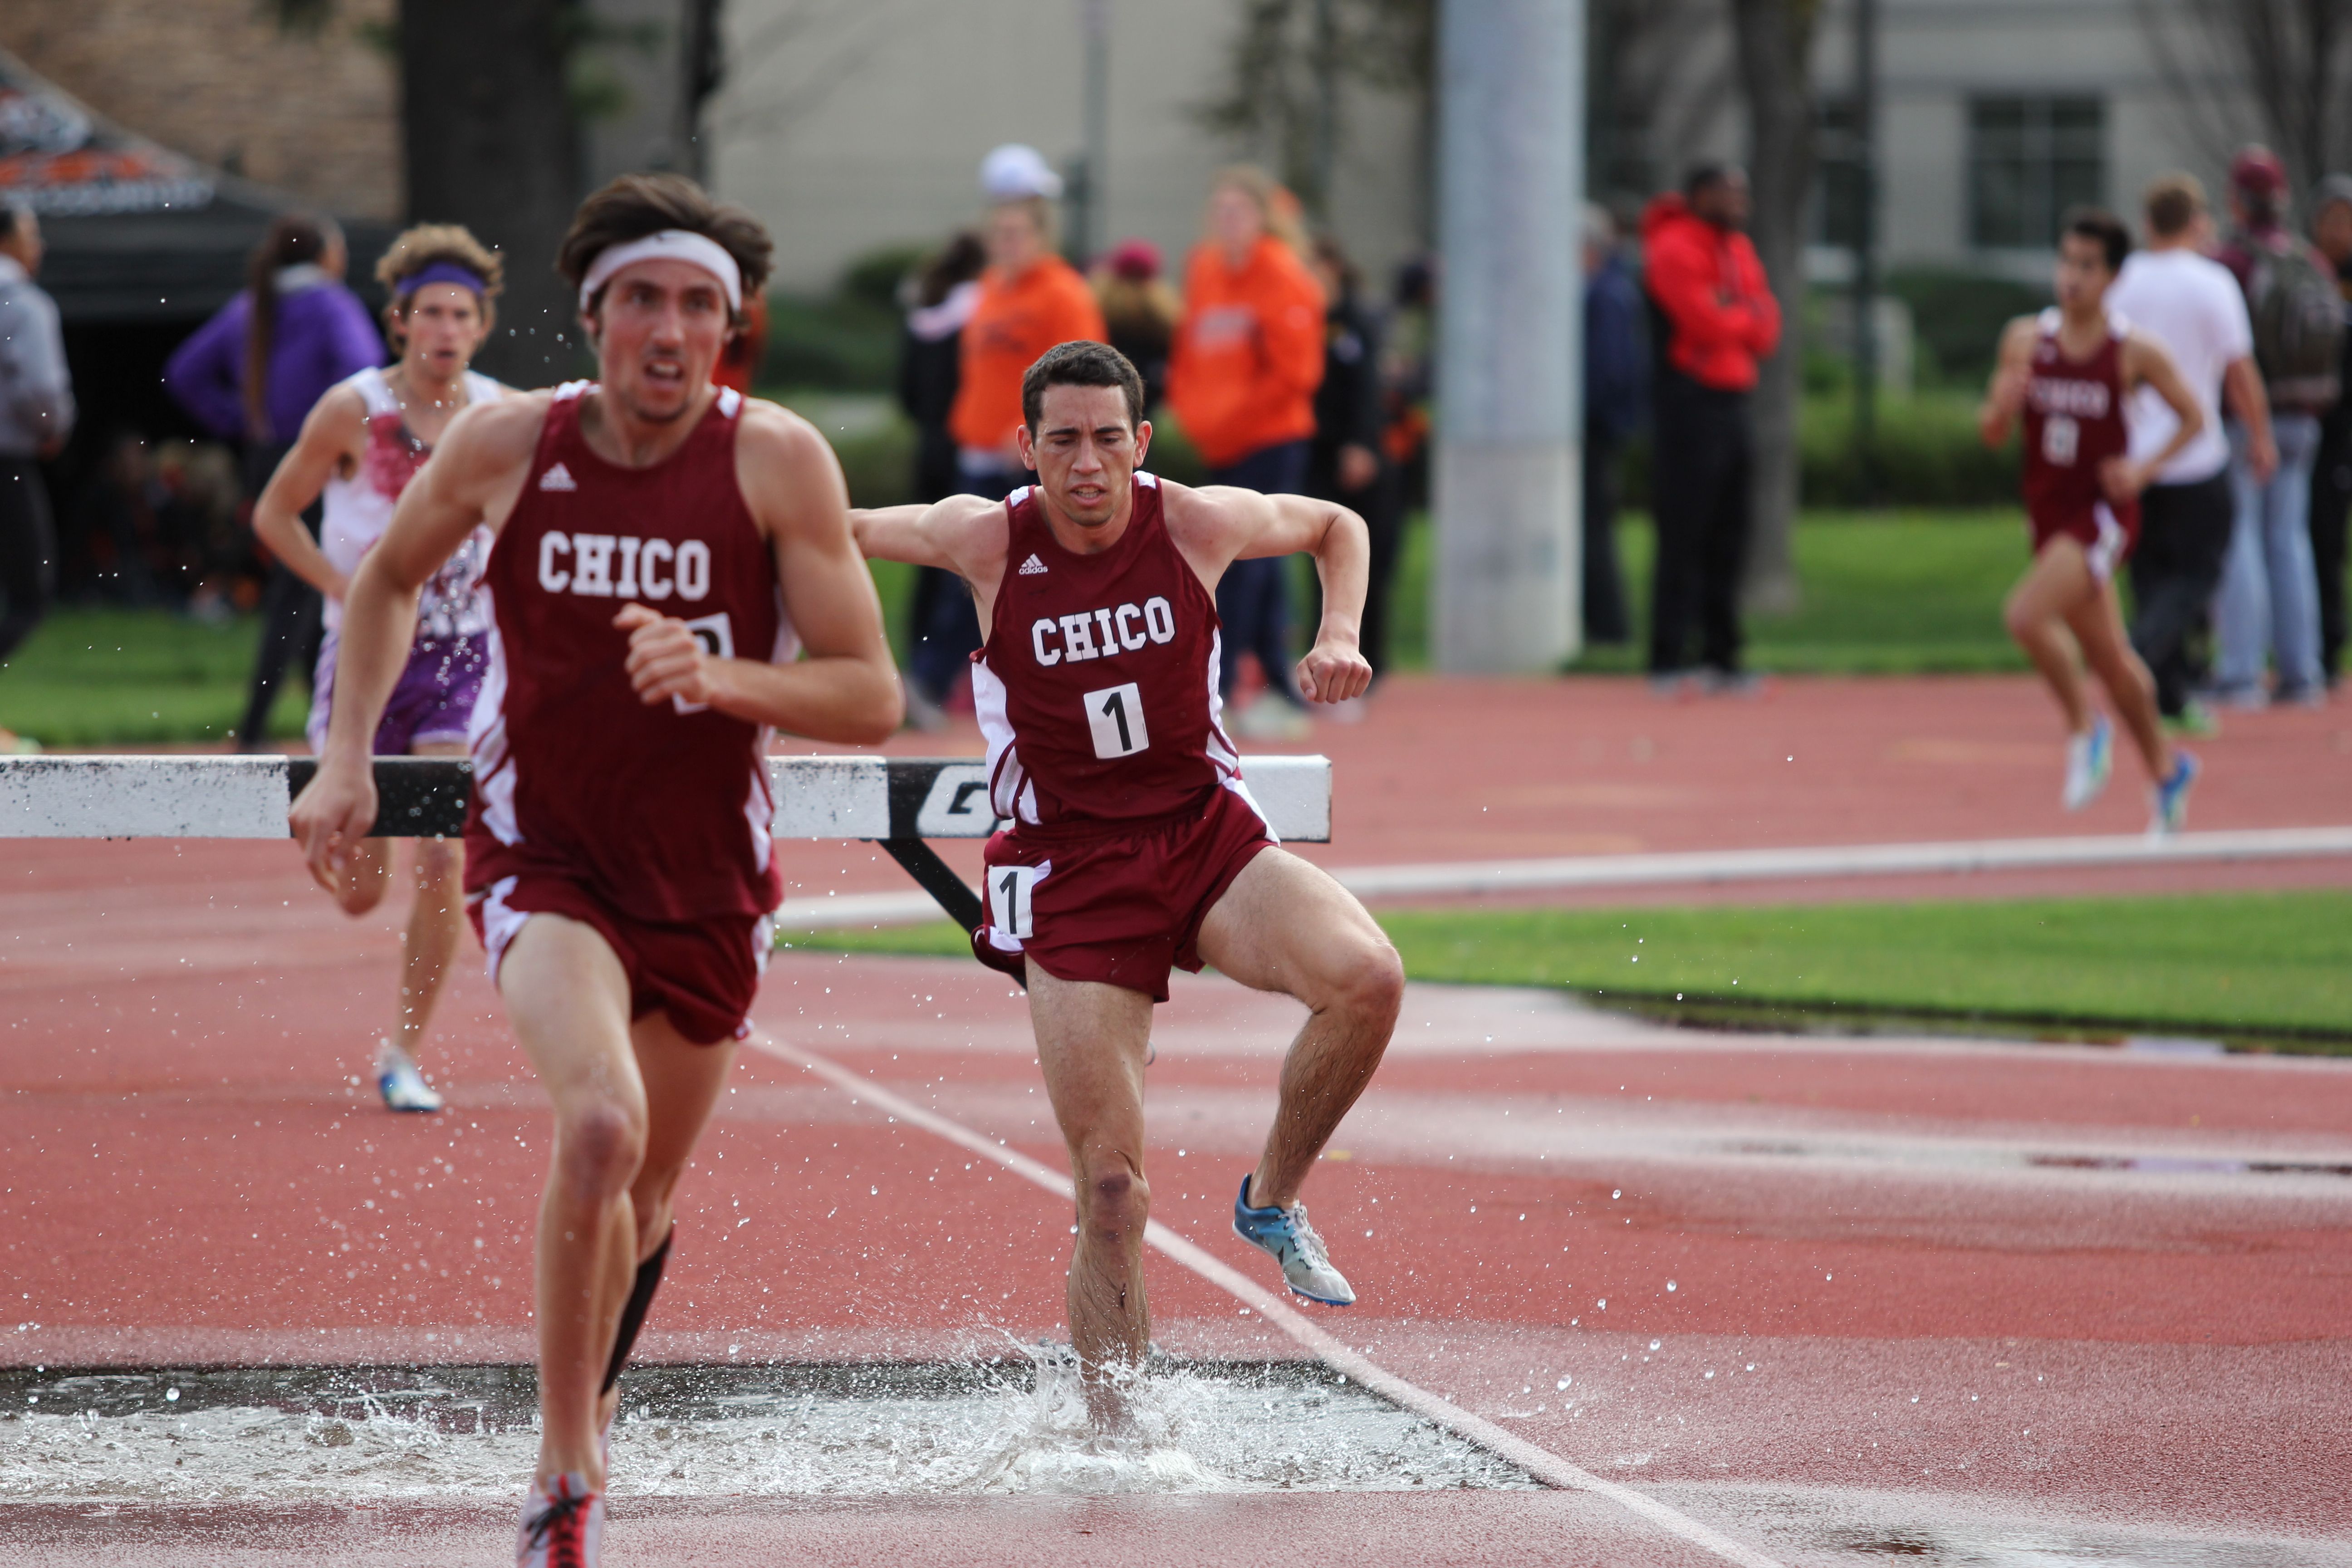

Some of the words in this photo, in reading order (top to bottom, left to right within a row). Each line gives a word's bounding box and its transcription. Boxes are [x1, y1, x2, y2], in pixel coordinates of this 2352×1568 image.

[539, 530, 710, 601] CHICO
[1019, 565, 1048, 575] adidas
[1031, 596, 1176, 666] CHICO
[1102, 691, 1133, 751] 1
[999, 871, 1018, 935] 1
